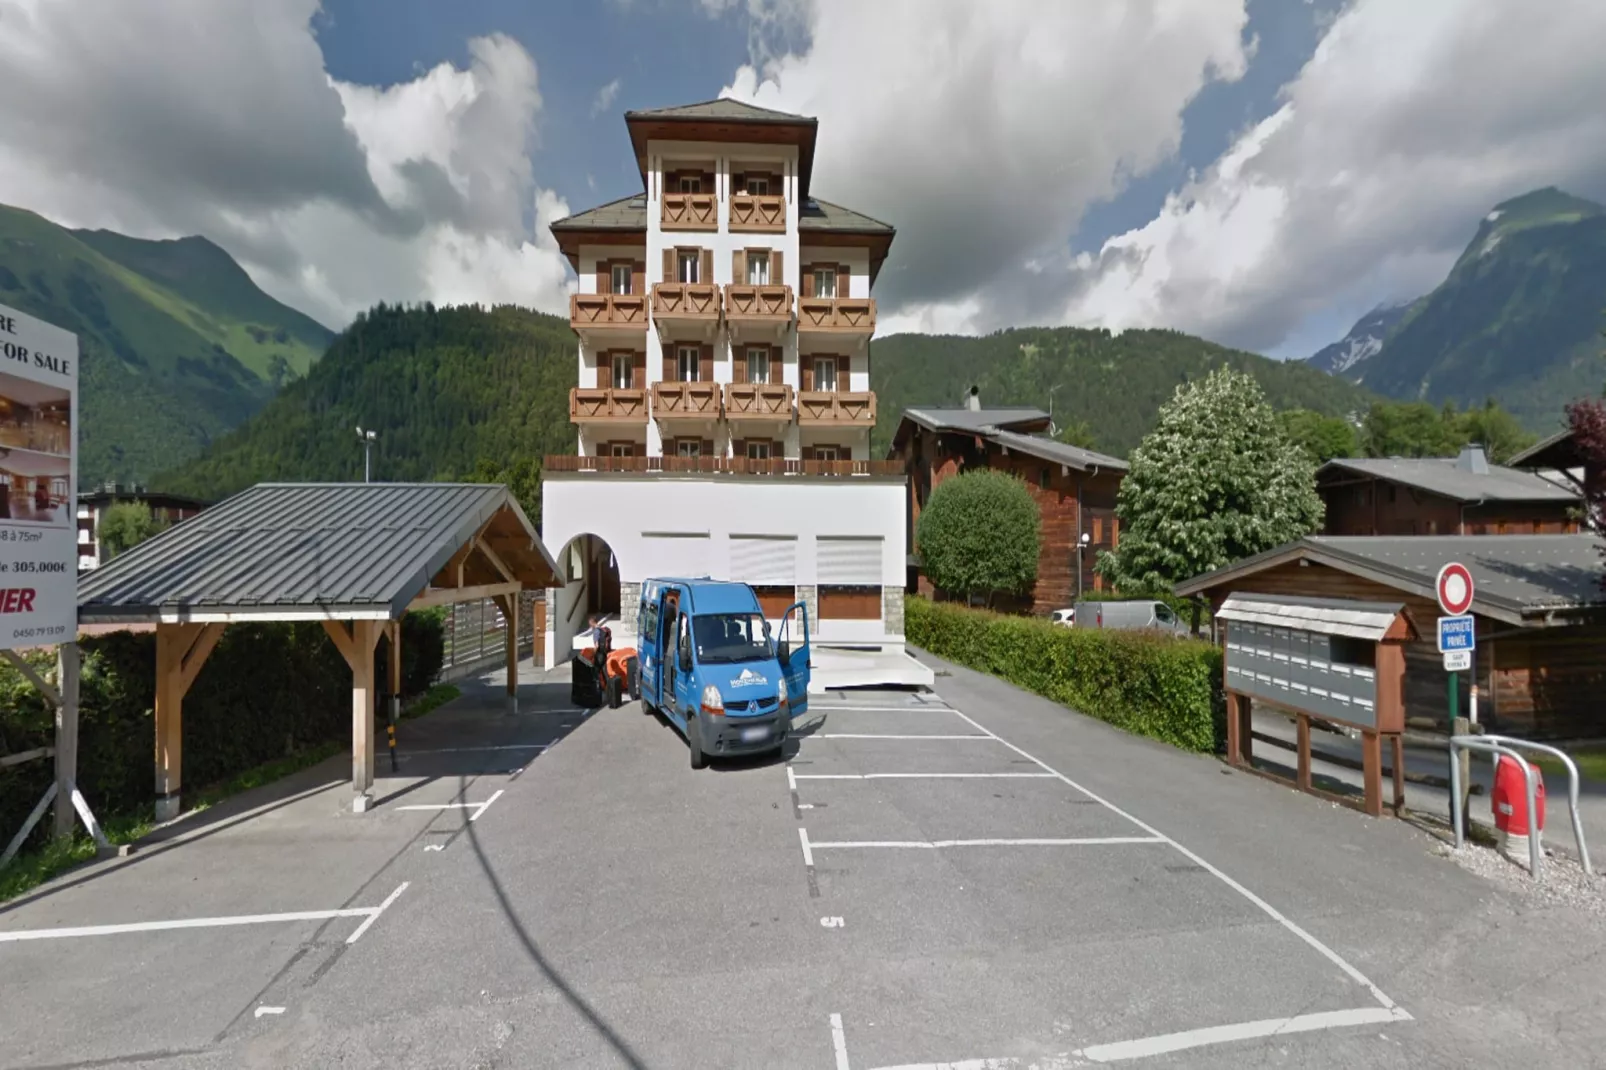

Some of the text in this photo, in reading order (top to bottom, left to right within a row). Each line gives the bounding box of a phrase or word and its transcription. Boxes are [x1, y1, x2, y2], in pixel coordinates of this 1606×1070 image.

[34, 351, 71, 377] SALE
[12, 561, 68, 574] 305,000€
[819, 915, 846, 928] 5
